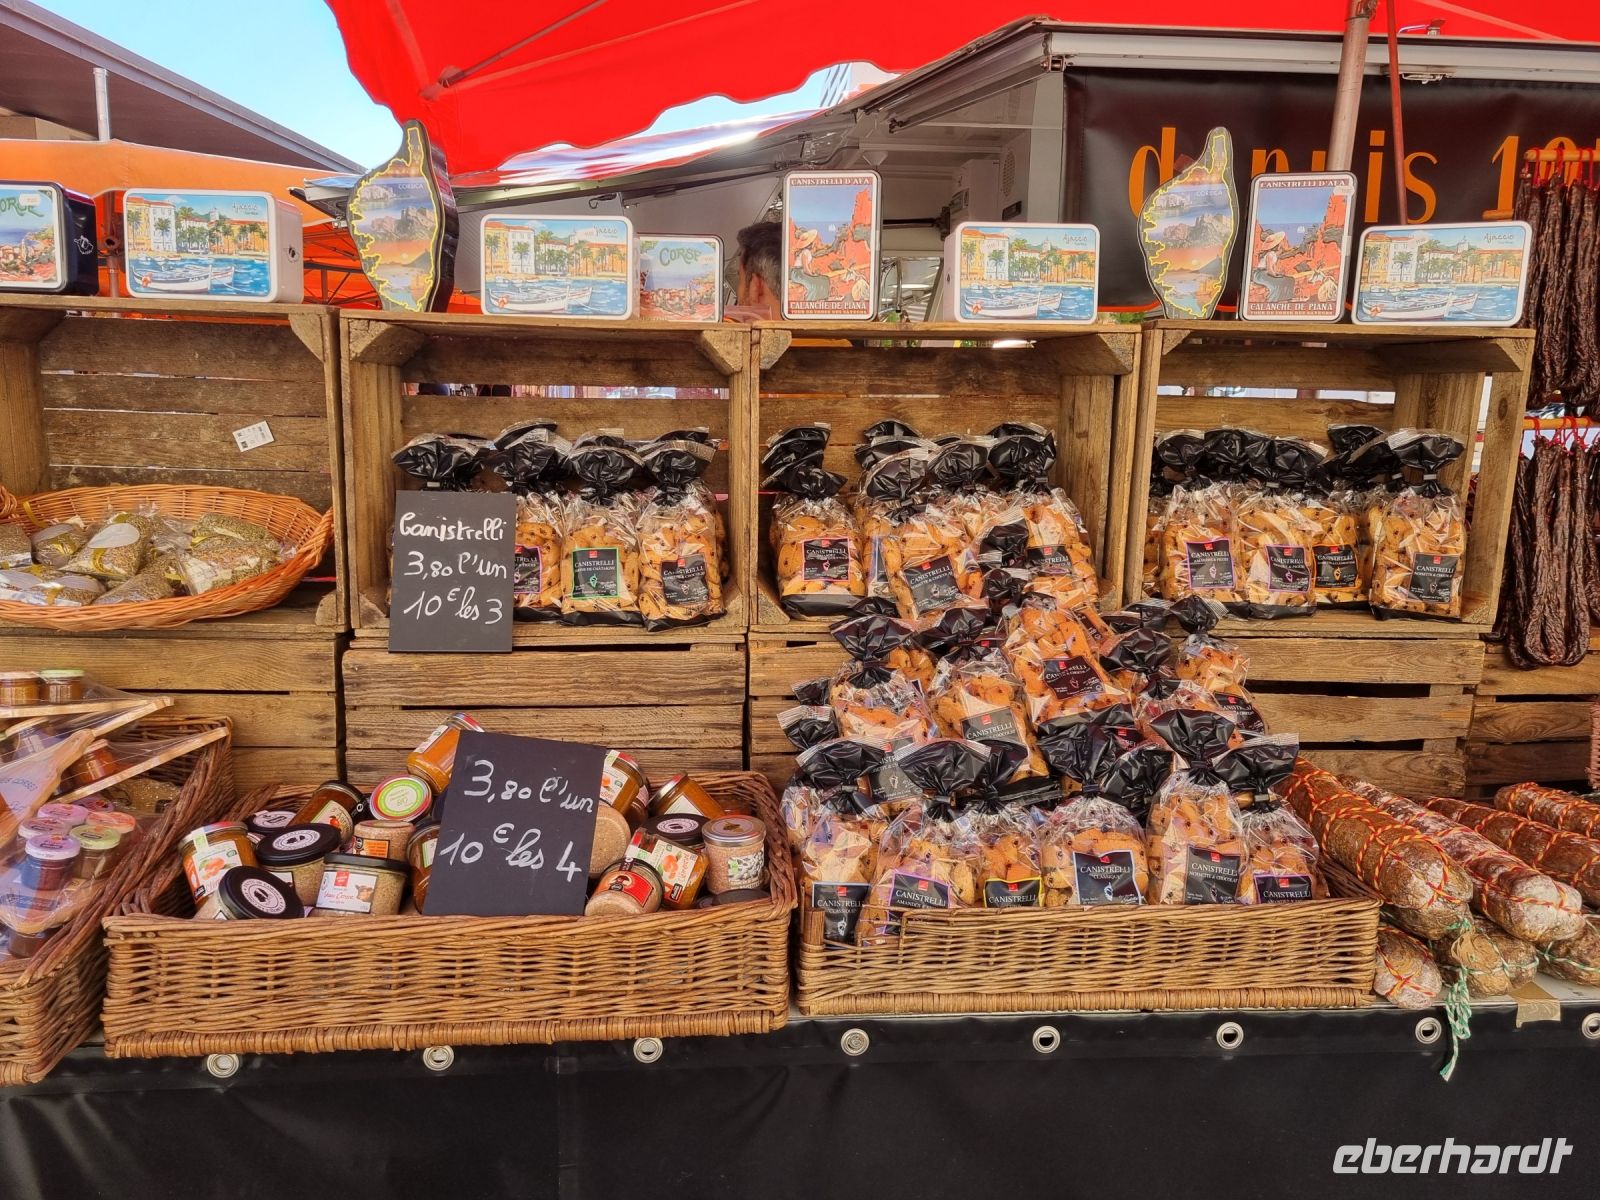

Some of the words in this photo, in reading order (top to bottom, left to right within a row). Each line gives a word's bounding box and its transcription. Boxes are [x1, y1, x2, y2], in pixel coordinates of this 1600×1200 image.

[1483, 232, 1514, 244] Ajaccio
[790, 301, 829, 310] CALANCHE
[832, 301, 842, 309] DE
[844, 301, 867, 309] PIANA
[1250, 303, 1291, 311] CALANCHE
[1294, 303, 1304, 311] DE
[1308, 303, 1333, 311] PIANA
[399, 512, 508, 541] Canistrelli
[1191, 550, 1230, 558] CANISTRELLI
[404, 550, 453, 580] 3,80
[459, 551, 507, 579] l'un
[575, 560, 616, 568] CANISTRELLI
[1416, 565, 1454, 574] CANISTRELLI
[910, 565, 950, 585] CANISTRELLI
[455, 586, 480, 621] les
[484, 598, 503, 624] 3
[966, 722, 1013, 740] CANISTRELLI
[464, 759, 532, 803] 3,80
[505, 828, 545, 870] les
[555, 840, 583, 883] 4
[1080, 865, 1131, 873] CANISTRELLI
[1191, 862, 1238, 876] CANISTRELLI
[896, 888, 947, 908] CANISTRELLI
[988, 894, 1036, 904] CANISTRELLI
[1263, 890, 1311, 899] CANISTRELLI
[817, 899, 862, 907] CANISTRELLI
